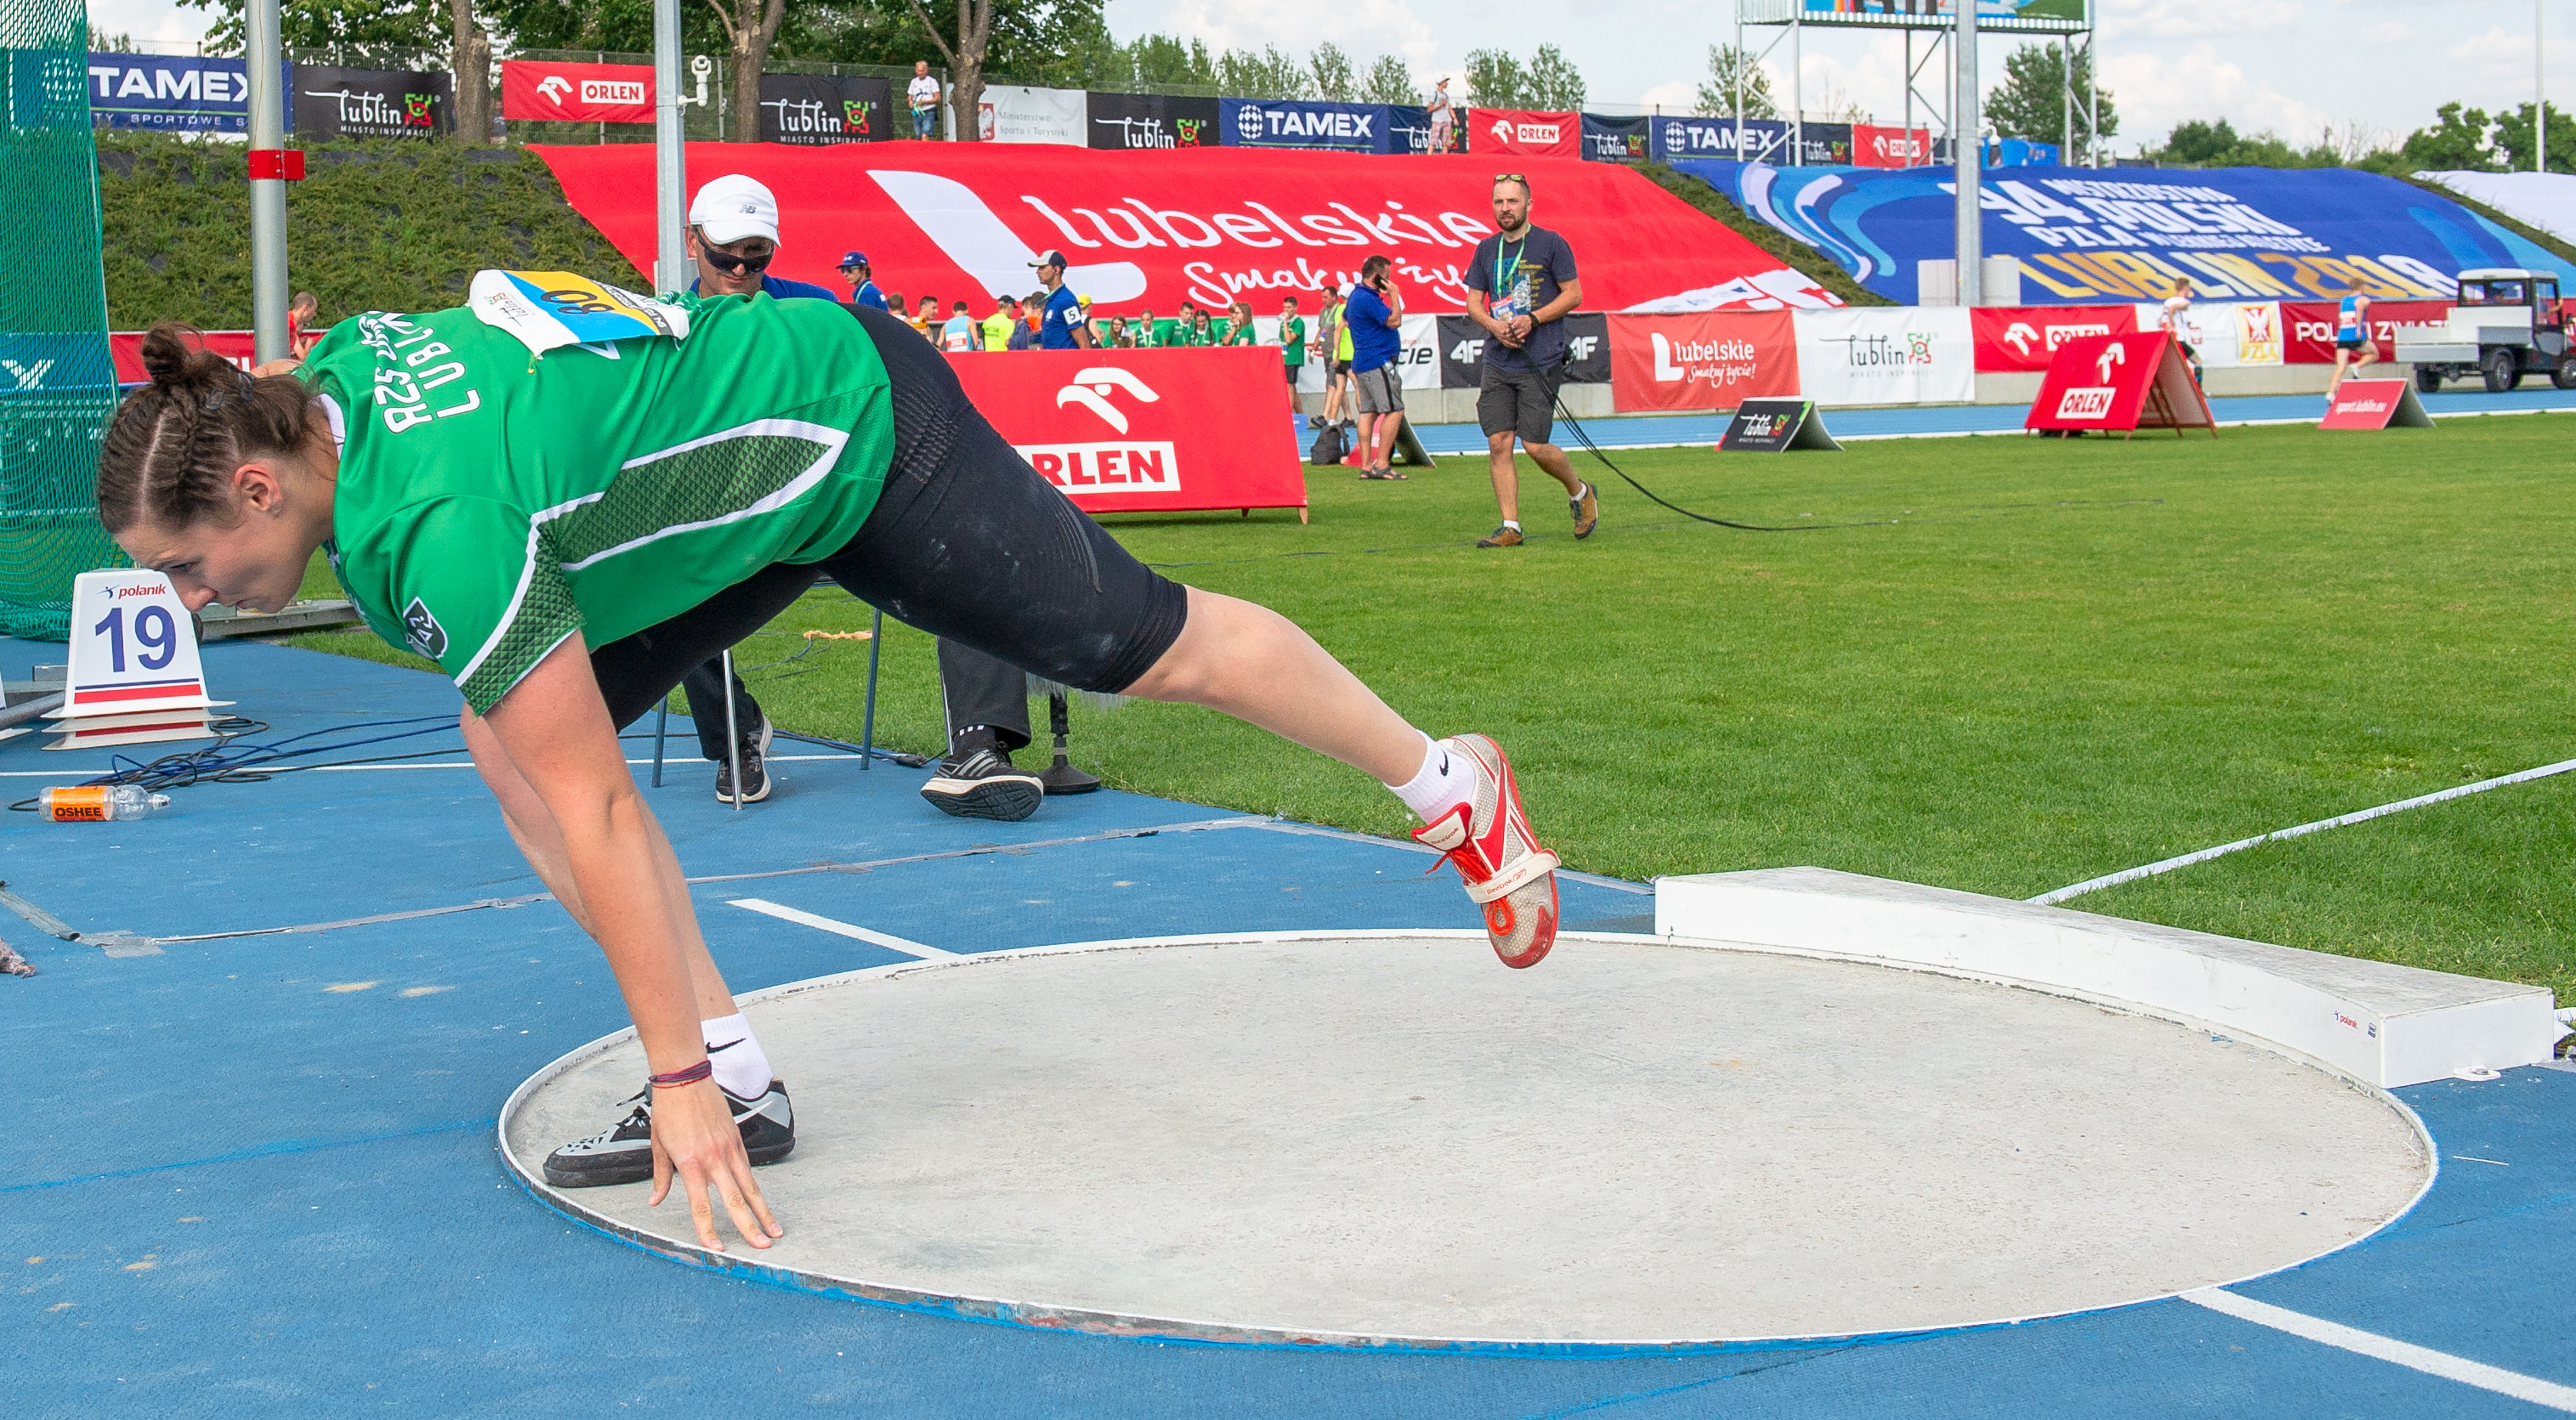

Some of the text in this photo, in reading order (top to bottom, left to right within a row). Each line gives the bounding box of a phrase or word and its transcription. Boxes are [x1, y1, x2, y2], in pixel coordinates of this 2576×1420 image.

[586, 84, 640, 100] ORLEN
[131, 114, 222, 127] SPORTOWE
[760, 98, 842, 133] lublin
[998, 111, 1053, 122] Ministerstwo
[1265, 110, 1373, 138] TAMEX
[340, 125, 375, 135] MIASTO
[780, 136, 815, 144] MIASTO
[1095, 116, 1176, 149] lublin
[1520, 127, 1556, 139] ORLEN
[1686, 127, 1774, 151] TAMEX
[2040, 179, 2238, 202] MISTRZOSTWA
[2074, 196, 2303, 236] POLSKI
[2021, 225, 2150, 248] PZLA
[1183, 257, 1361, 309] Smaku
[1991, 251, 2307, 299] LUBLIN
[541, 290, 615, 315] 80
[1067, 310, 1076, 320] 5
[1450, 339, 1486, 364] 4F
[1674, 339, 1755, 363] lubelskie
[1818, 334, 1904, 366] lublin
[2063, 393, 2109, 413] ORLEN
[1032, 450, 1165, 486] RLEN
[118, 584, 167, 600] polanik
[95, 605, 177, 673] 19
[55, 807, 101, 817] OSHEE
[1486, 879, 1513, 895] Reebok
